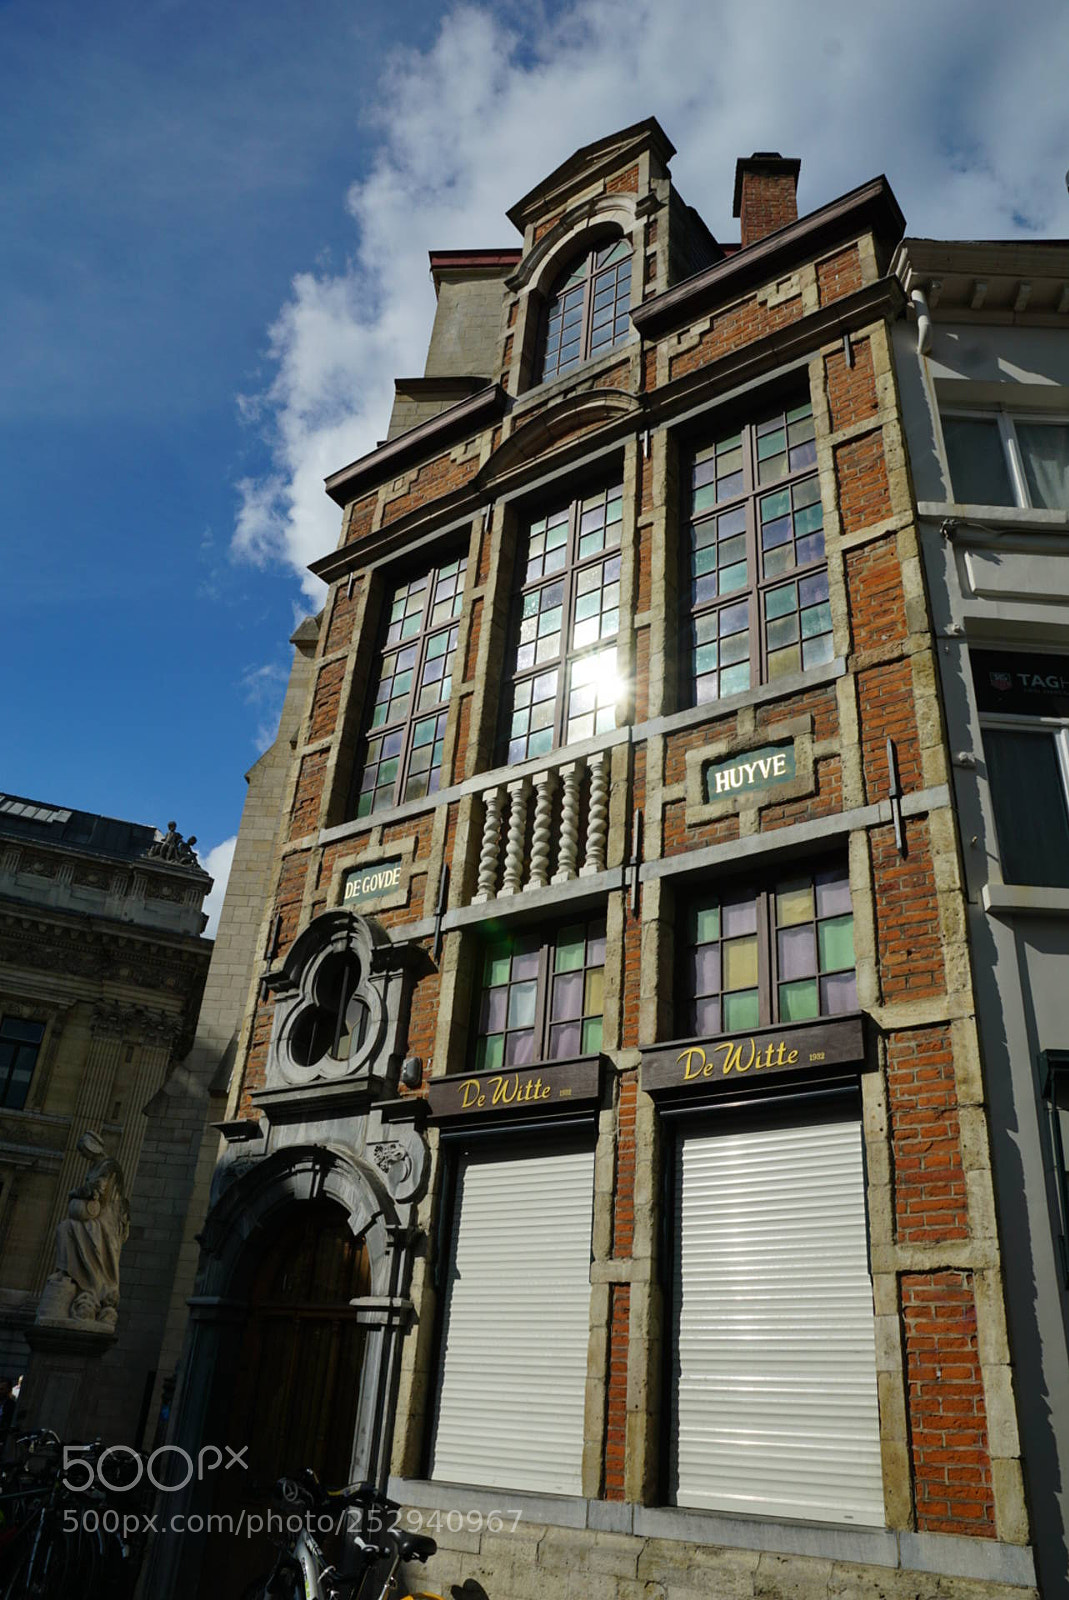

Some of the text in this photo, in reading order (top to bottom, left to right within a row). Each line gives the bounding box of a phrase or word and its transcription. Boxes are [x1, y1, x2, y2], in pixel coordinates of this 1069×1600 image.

[714, 753, 787, 794] HUYVE
[344, 879, 362, 900] DE
[676, 1046, 714, 1081] De
[715, 1038, 799, 1075] Witte
[458, 1073, 551, 1109] De Witte
